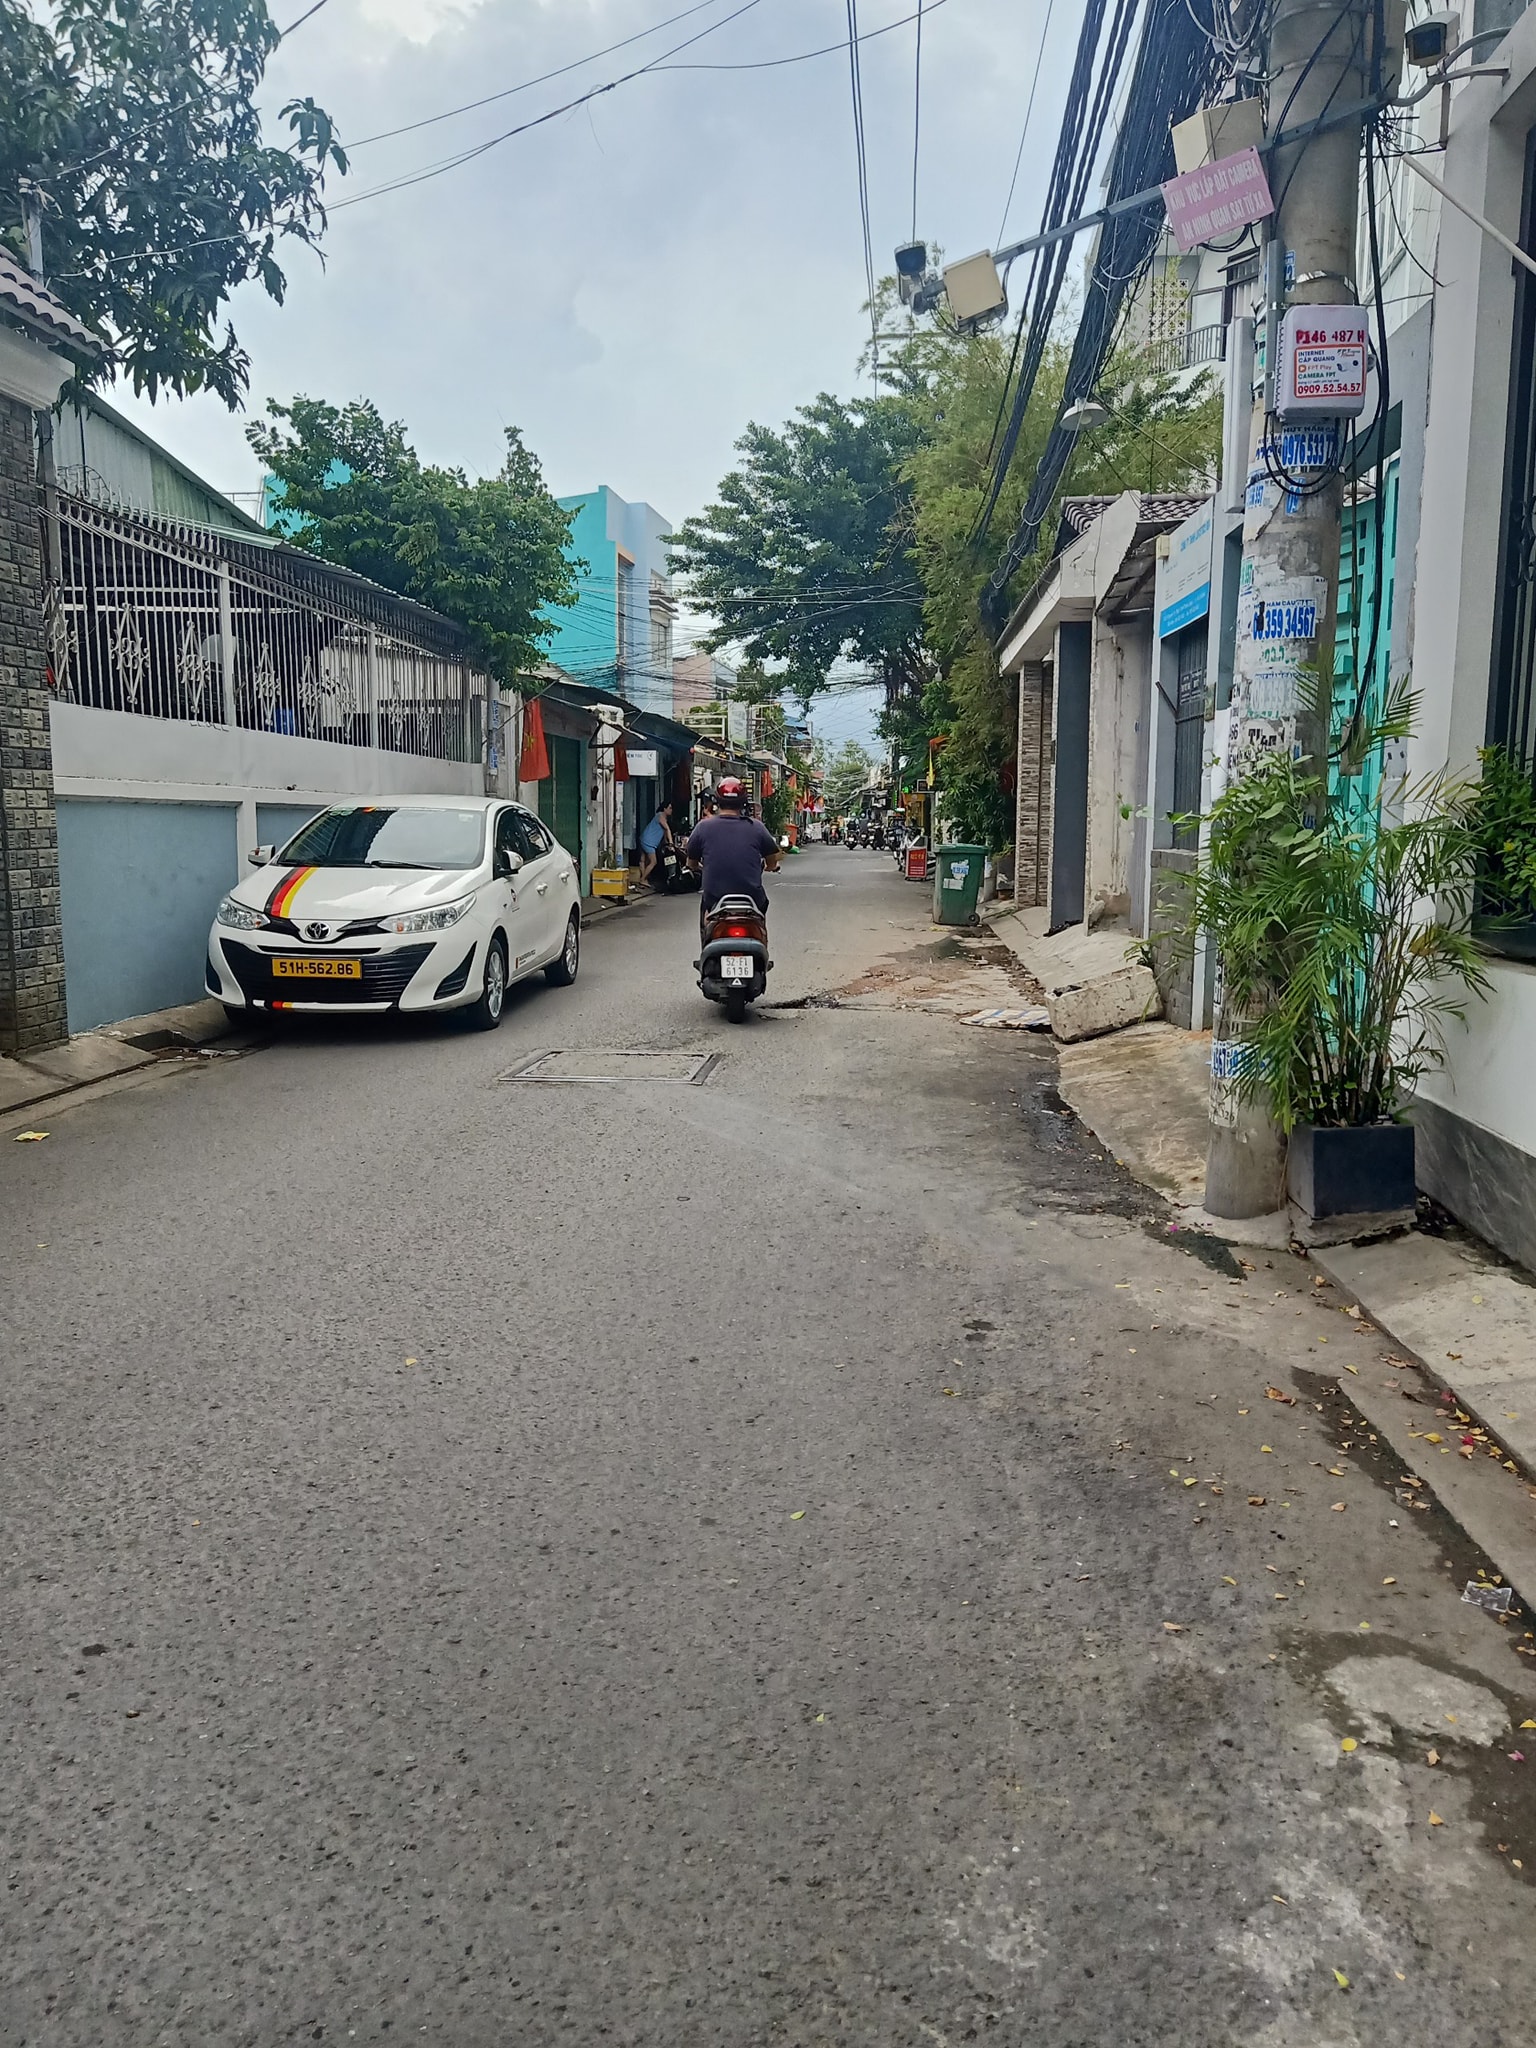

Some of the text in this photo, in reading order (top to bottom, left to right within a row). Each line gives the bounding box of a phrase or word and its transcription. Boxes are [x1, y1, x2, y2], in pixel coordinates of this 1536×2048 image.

[1170, 189, 1186, 211] KHU
[1228, 158, 1260, 186] CAMERA
[1182, 222, 1196, 242] AN
[1192, 214, 1212, 237] NINH
[1210, 205, 1232, 230] QUAN
[1230, 198, 1245, 221] SÁT
[1254, 190, 1266, 210] XA
[1357, 330, 1364, 342] H
[1298, 383, 1360, 394] 0909.52.54.57
[1253, 607, 1315, 640] 0.359.34567
[280, 962, 353, 975] 51H-562.86
[727, 968, 749, 976] 6136
